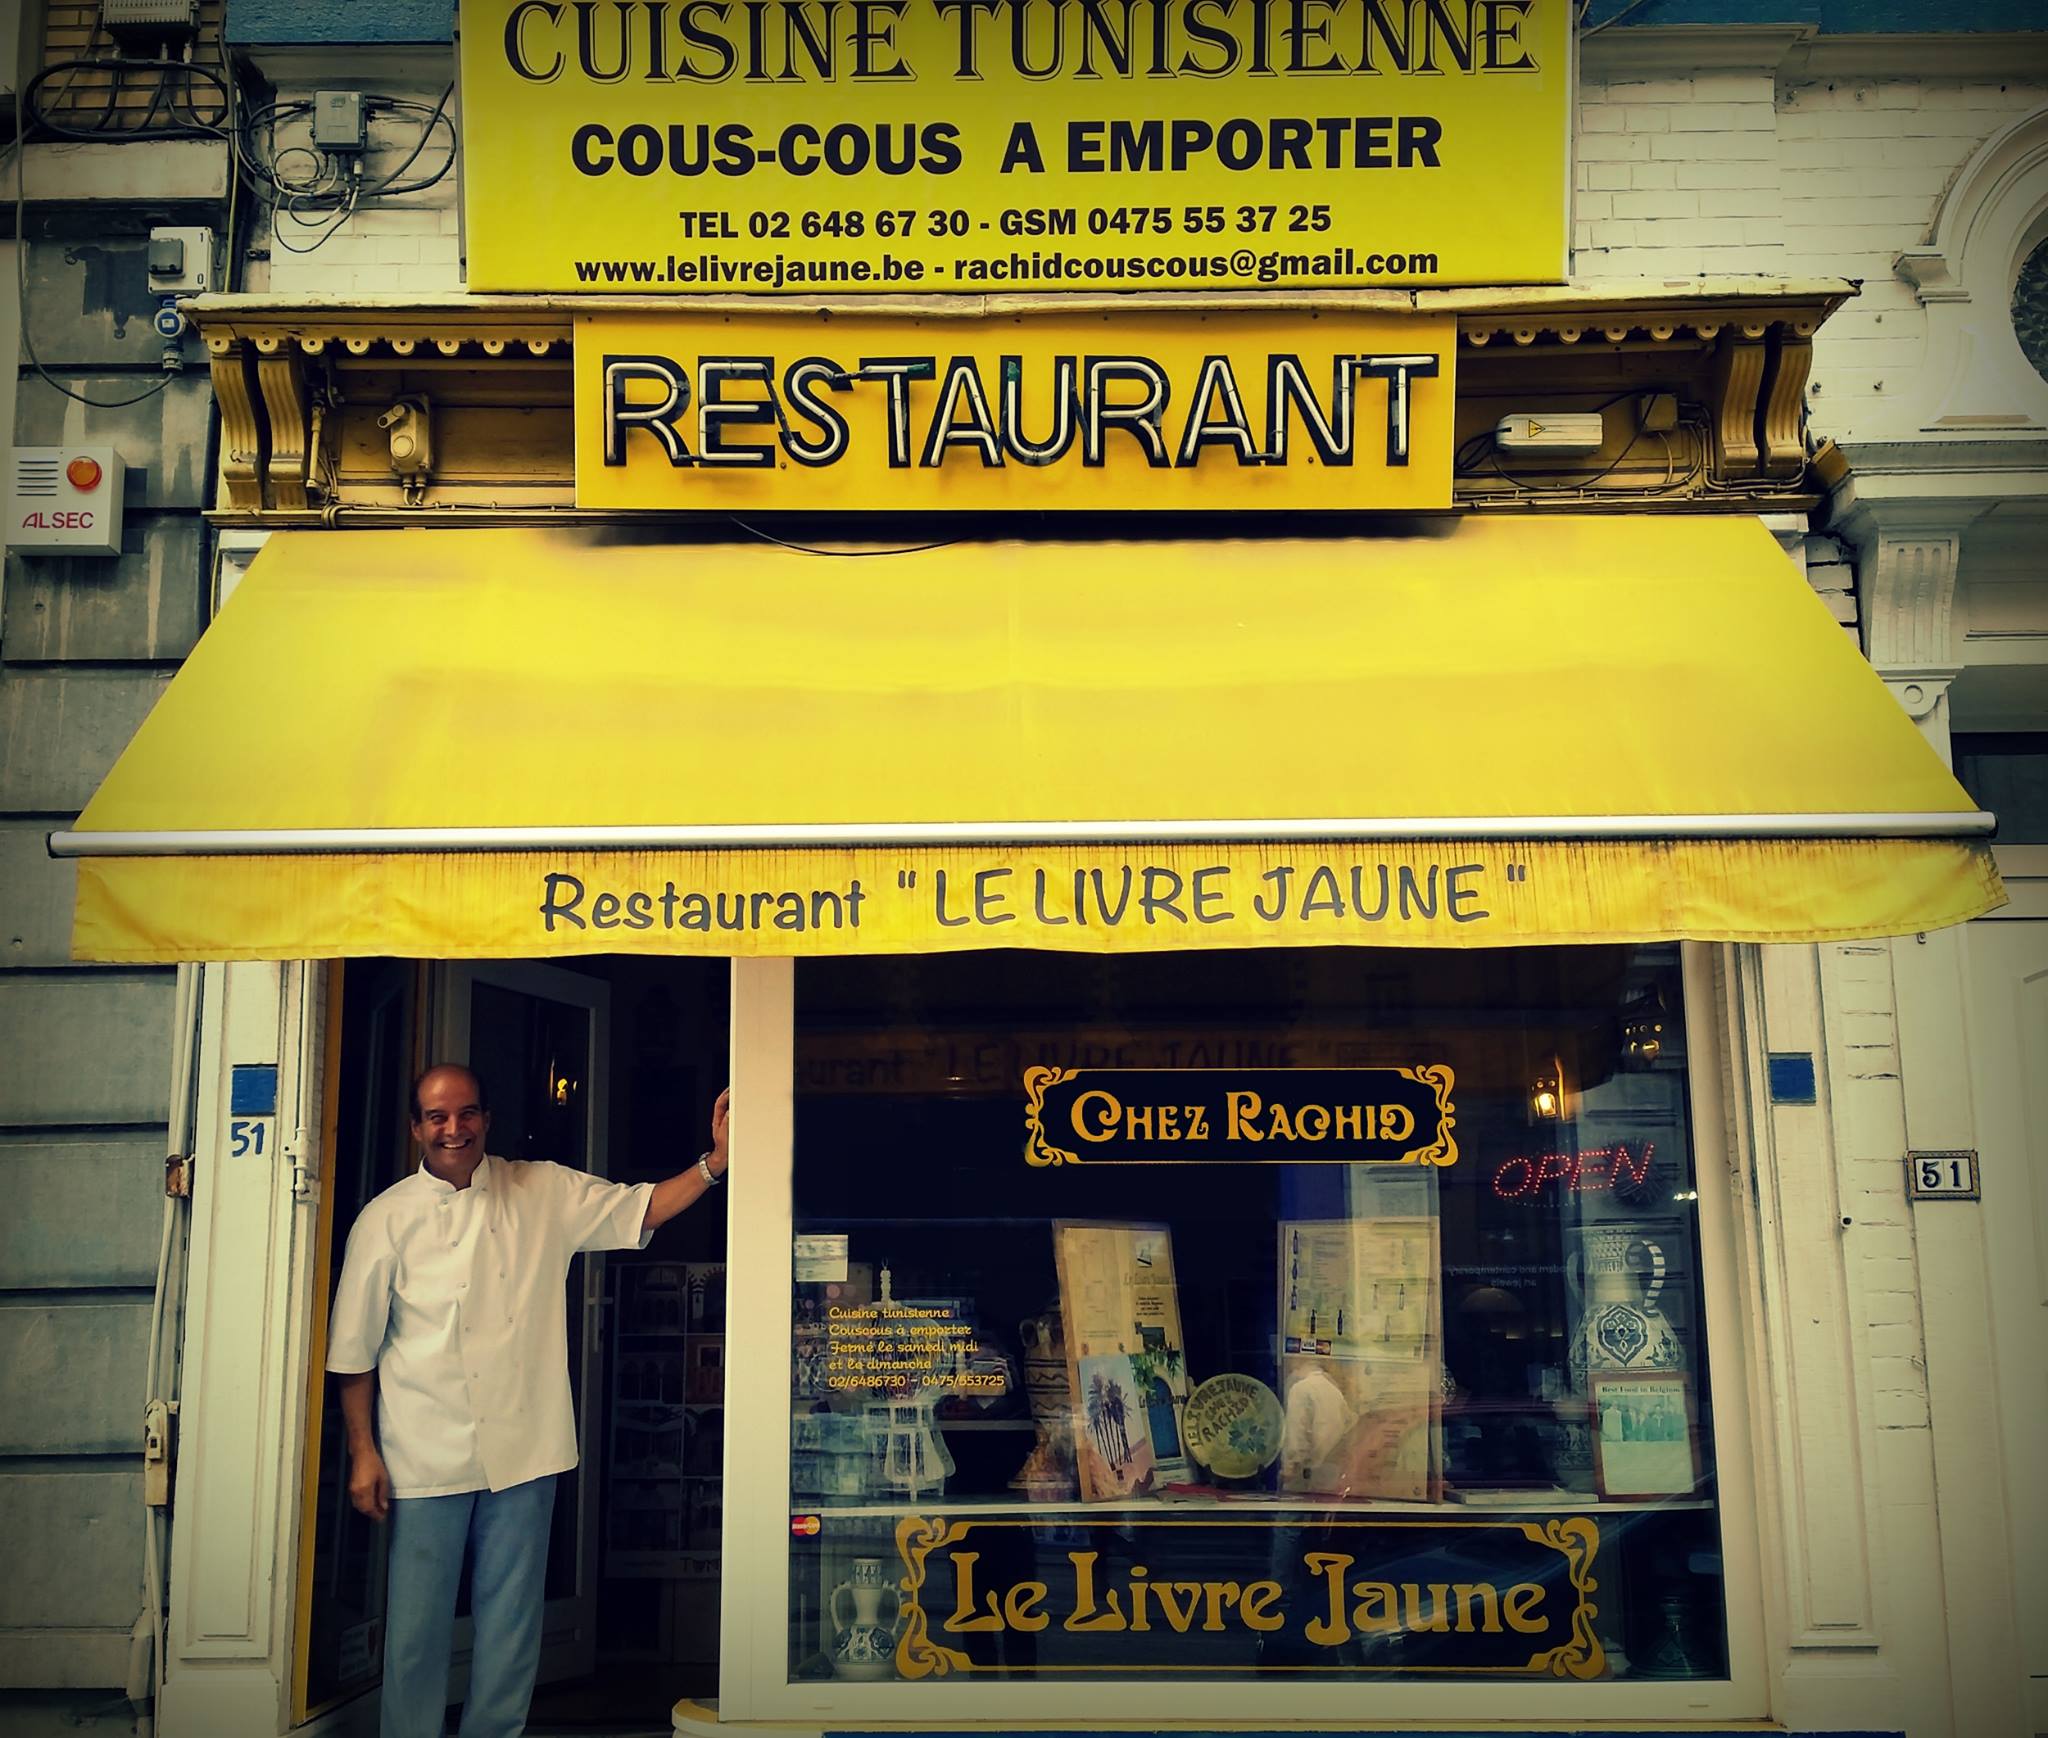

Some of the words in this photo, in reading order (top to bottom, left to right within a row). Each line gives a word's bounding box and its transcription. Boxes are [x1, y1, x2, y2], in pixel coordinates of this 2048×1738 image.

[504, 0, 917, 84] CUISINE
[932, 0, 1542, 81] TUNISIENNE
[572, 123, 961, 176] COUS-COUS
[1000, 122, 1045, 173] A
[1068, 117, 1441, 172] EMPORTER
[680, 212, 738, 237] TEL
[749, 212, 789, 238] 02
[802, 211, 864, 237] 648
[876, 211, 916, 237] 67
[928, 210, 969, 236] 30
[1000, 209, 1075, 235] GSM
[1088, 208, 1172, 234] 0475
[1184, 207, 1225, 233] 55
[1237, 206, 1277, 232] 37
[1289, 206, 1330, 231] 25
[575, 255, 923, 287] www.lelivrejaune.be
[956, 249, 1438, 282] rachidcouscous@gmail.com
[603, 354, 1439, 468] RESTAURANT
[22, 512, 94, 529] ALSEC
[540, 873, 865, 931] Restaurant
[1036, 865, 1233, 925] LIVRE
[231, 1121, 264, 1157] 51
[1492, 1143, 1655, 1197] OPEN
[1922, 1161, 1961, 1188] 51
[829, 1306, 878, 1319] Cuisine
[883, 1307, 950, 1319] tunisienne
[829, 1324, 892, 1336] Couscous
[910, 1325, 972, 1338] emporter
[878, 1341, 895, 1352] le
[898, 1340, 944, 1353] samedi
[950, 1340, 979, 1353] midi
[829, 1360, 842, 1370] et
[848, 1359, 864, 1370] le
[867, 1359, 931, 1370] dimanche
[829, 1375, 906, 1388] 02/6486730
[922, 1375, 1005, 1387] 0475/553725
[943, 1552, 1049, 1632] Le
[1064, 1552, 1284, 1632] Livre
[1304, 1553, 1549, 1646] Jaune
